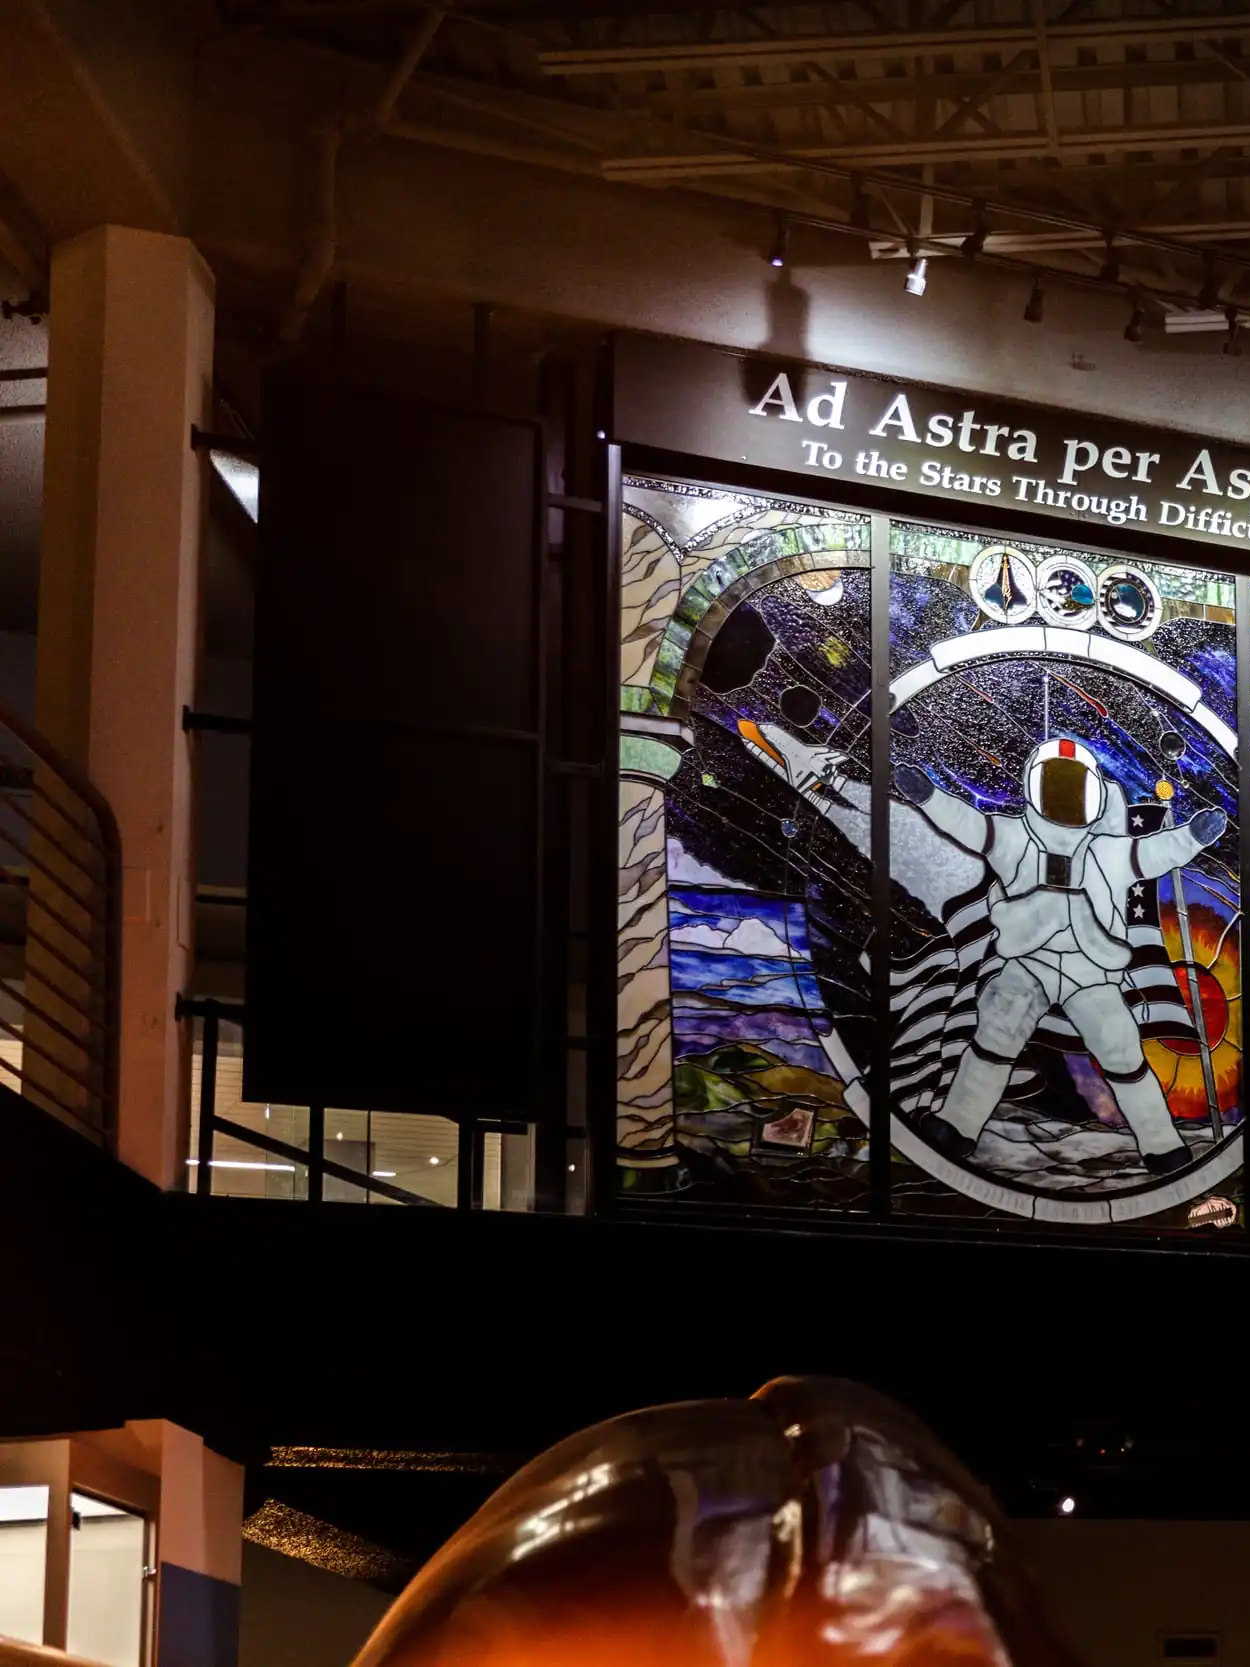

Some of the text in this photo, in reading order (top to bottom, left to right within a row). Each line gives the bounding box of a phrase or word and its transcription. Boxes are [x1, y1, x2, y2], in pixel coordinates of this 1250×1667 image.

[748, 372, 848, 430] Ad
[868, 393, 1039, 464] Astra
[1056, 438, 1161, 486] per
[801, 439, 844, 470] To
[855, 450, 908, 481] the
[919, 460, 1002, 497] Stars
[1012, 475, 1149, 525] Through
